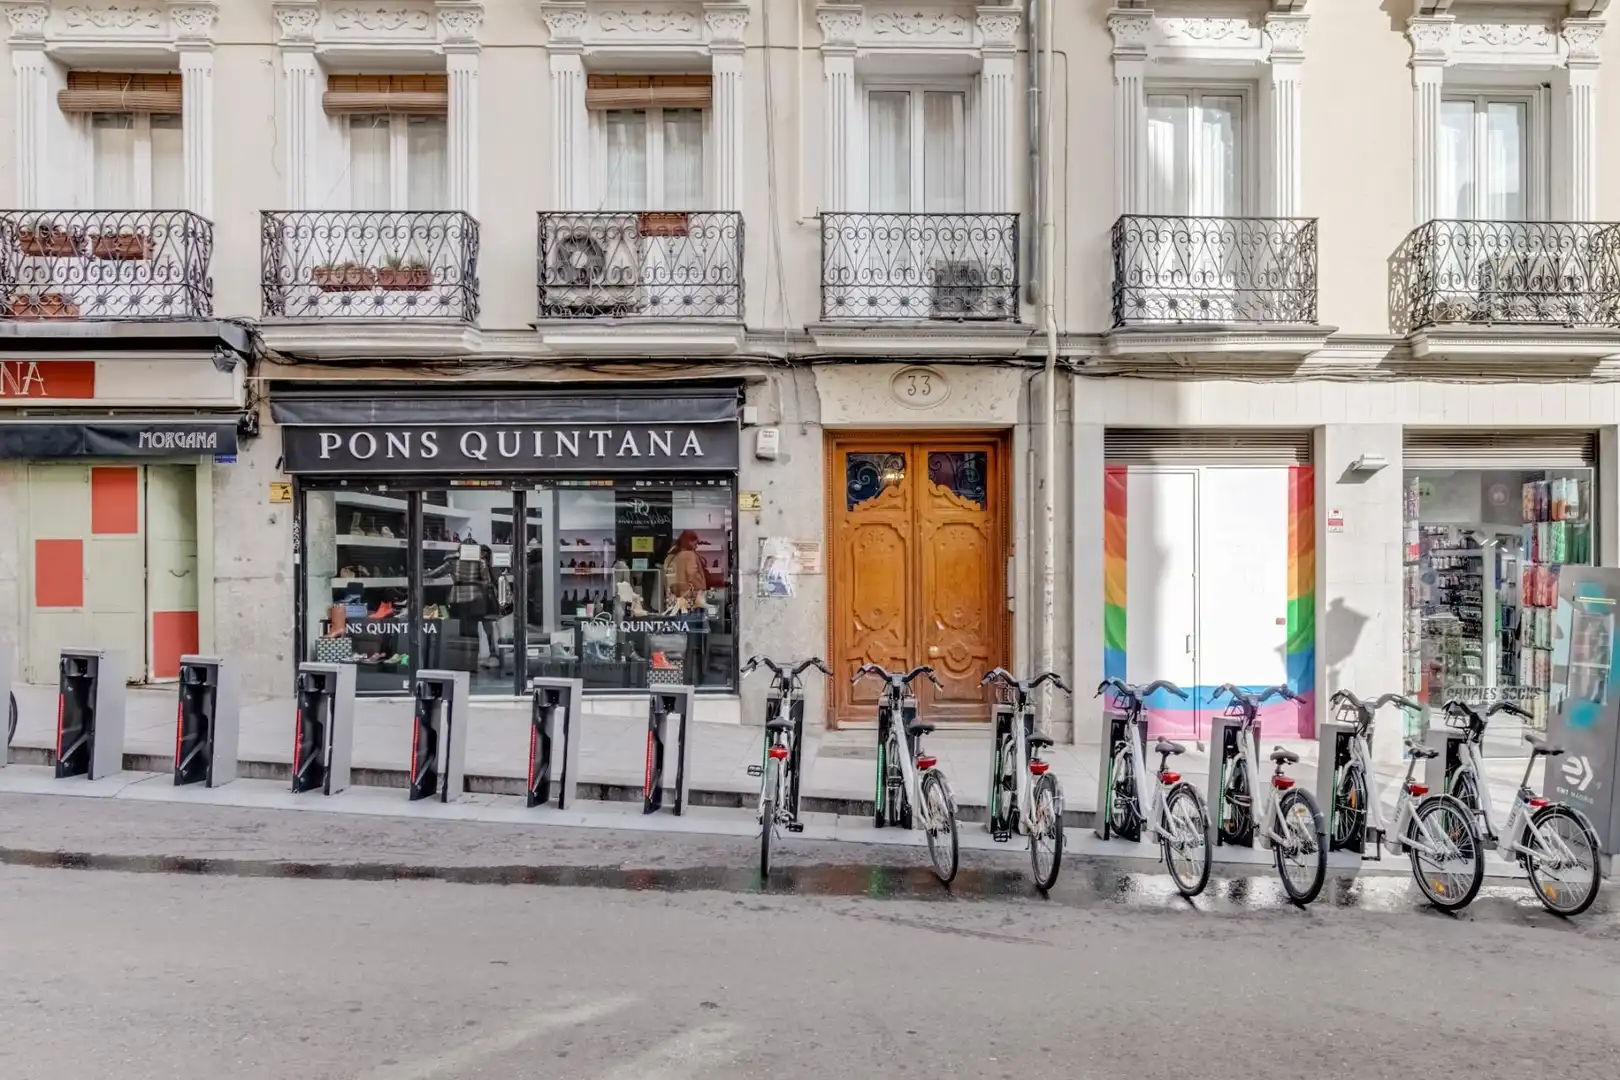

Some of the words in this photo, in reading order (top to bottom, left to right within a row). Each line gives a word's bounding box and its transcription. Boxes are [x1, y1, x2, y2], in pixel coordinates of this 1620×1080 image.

[0, 361, 48, 396] NA
[907, 375, 932, 397] 33
[138, 431, 218, 449] MORGANA
[318, 431, 438, 460] PONS
[459, 429, 705, 461] QUINTANA
[366, 622, 438, 635] QUINTNA
